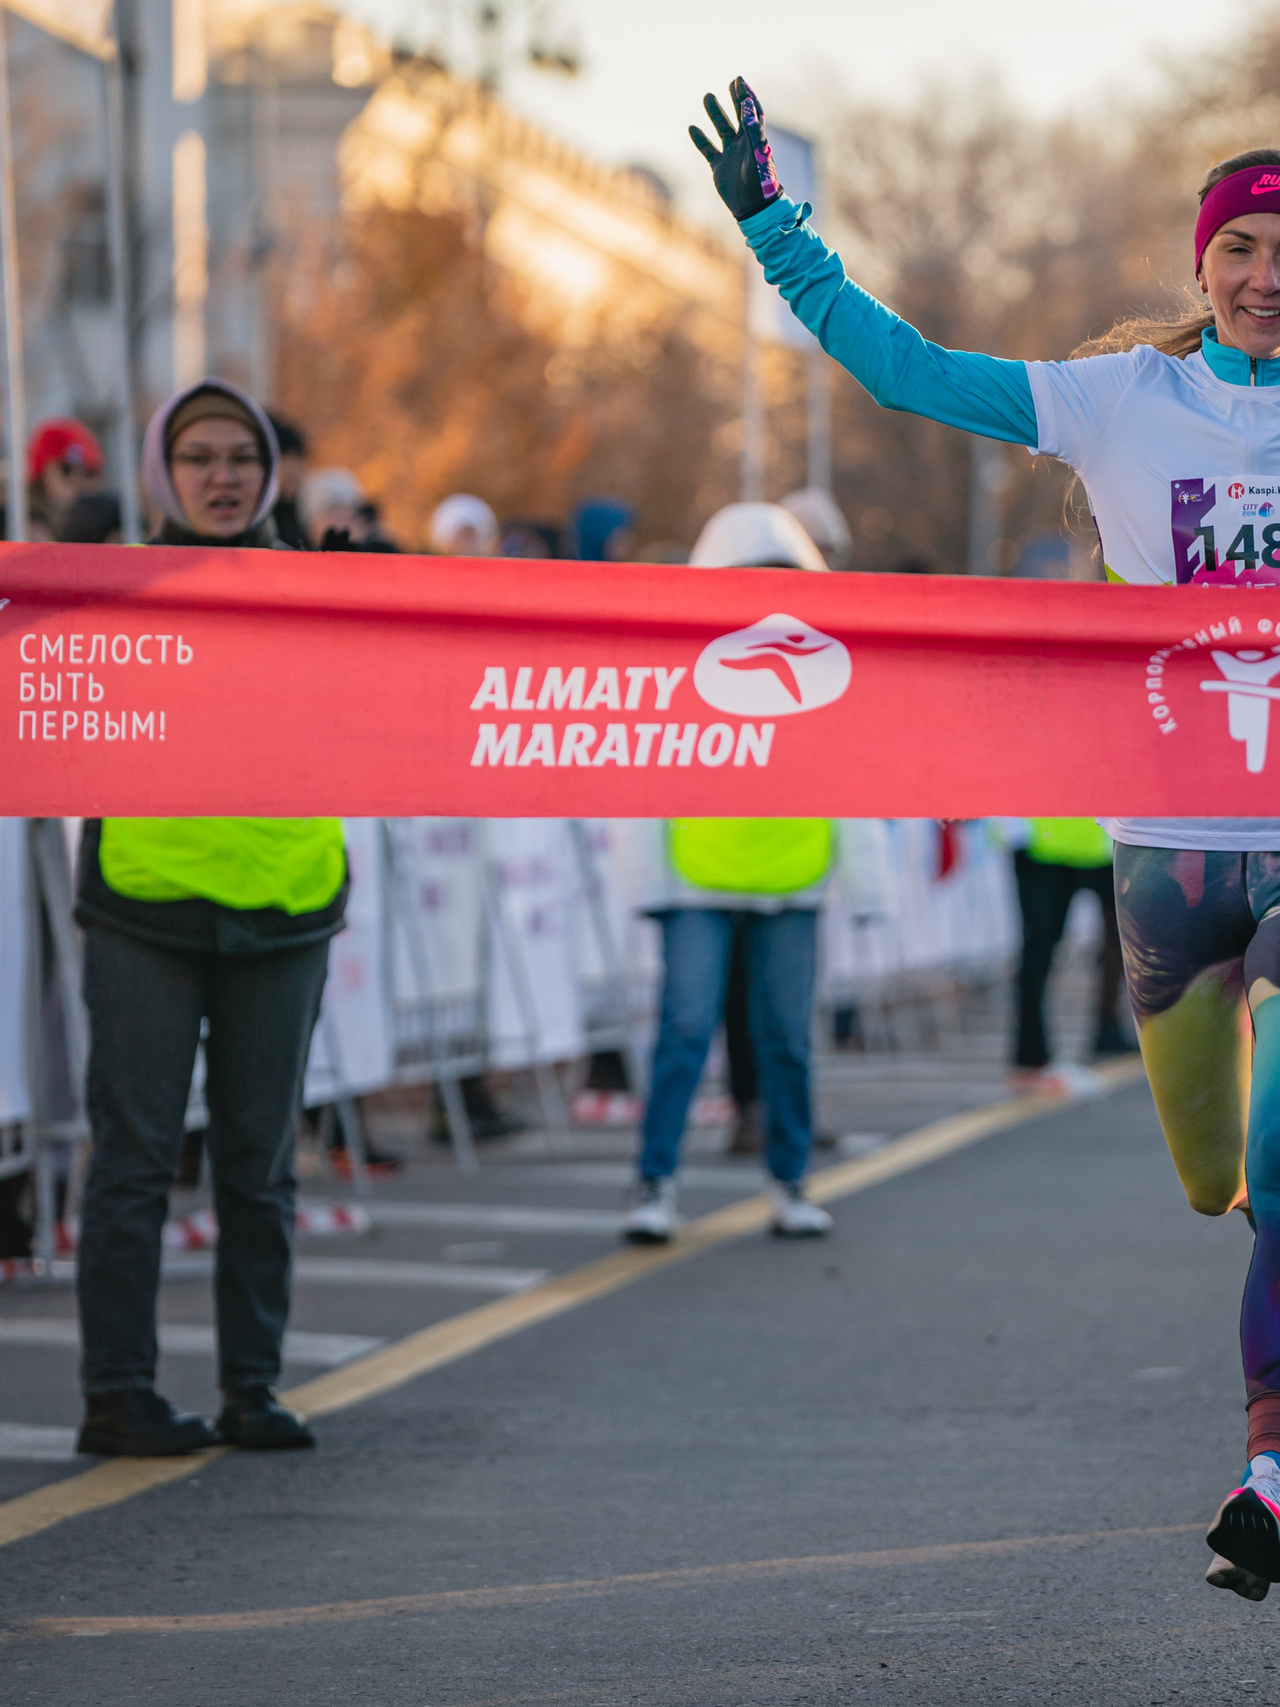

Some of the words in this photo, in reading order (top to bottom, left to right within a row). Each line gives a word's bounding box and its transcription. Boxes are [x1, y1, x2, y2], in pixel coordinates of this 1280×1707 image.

[1242, 503, 1258, 511] CITY
[19, 633, 194, 665] СМЕЛОСТЬ
[19, 672, 105, 702] БЫТЬ
[469, 666, 687, 710] ALMATY
[1145, 616, 1242, 734] КОРПОРВНЫЙ
[18, 710, 166, 741] ПЕРВЫМ!
[470, 722, 775, 767] MARATHON
